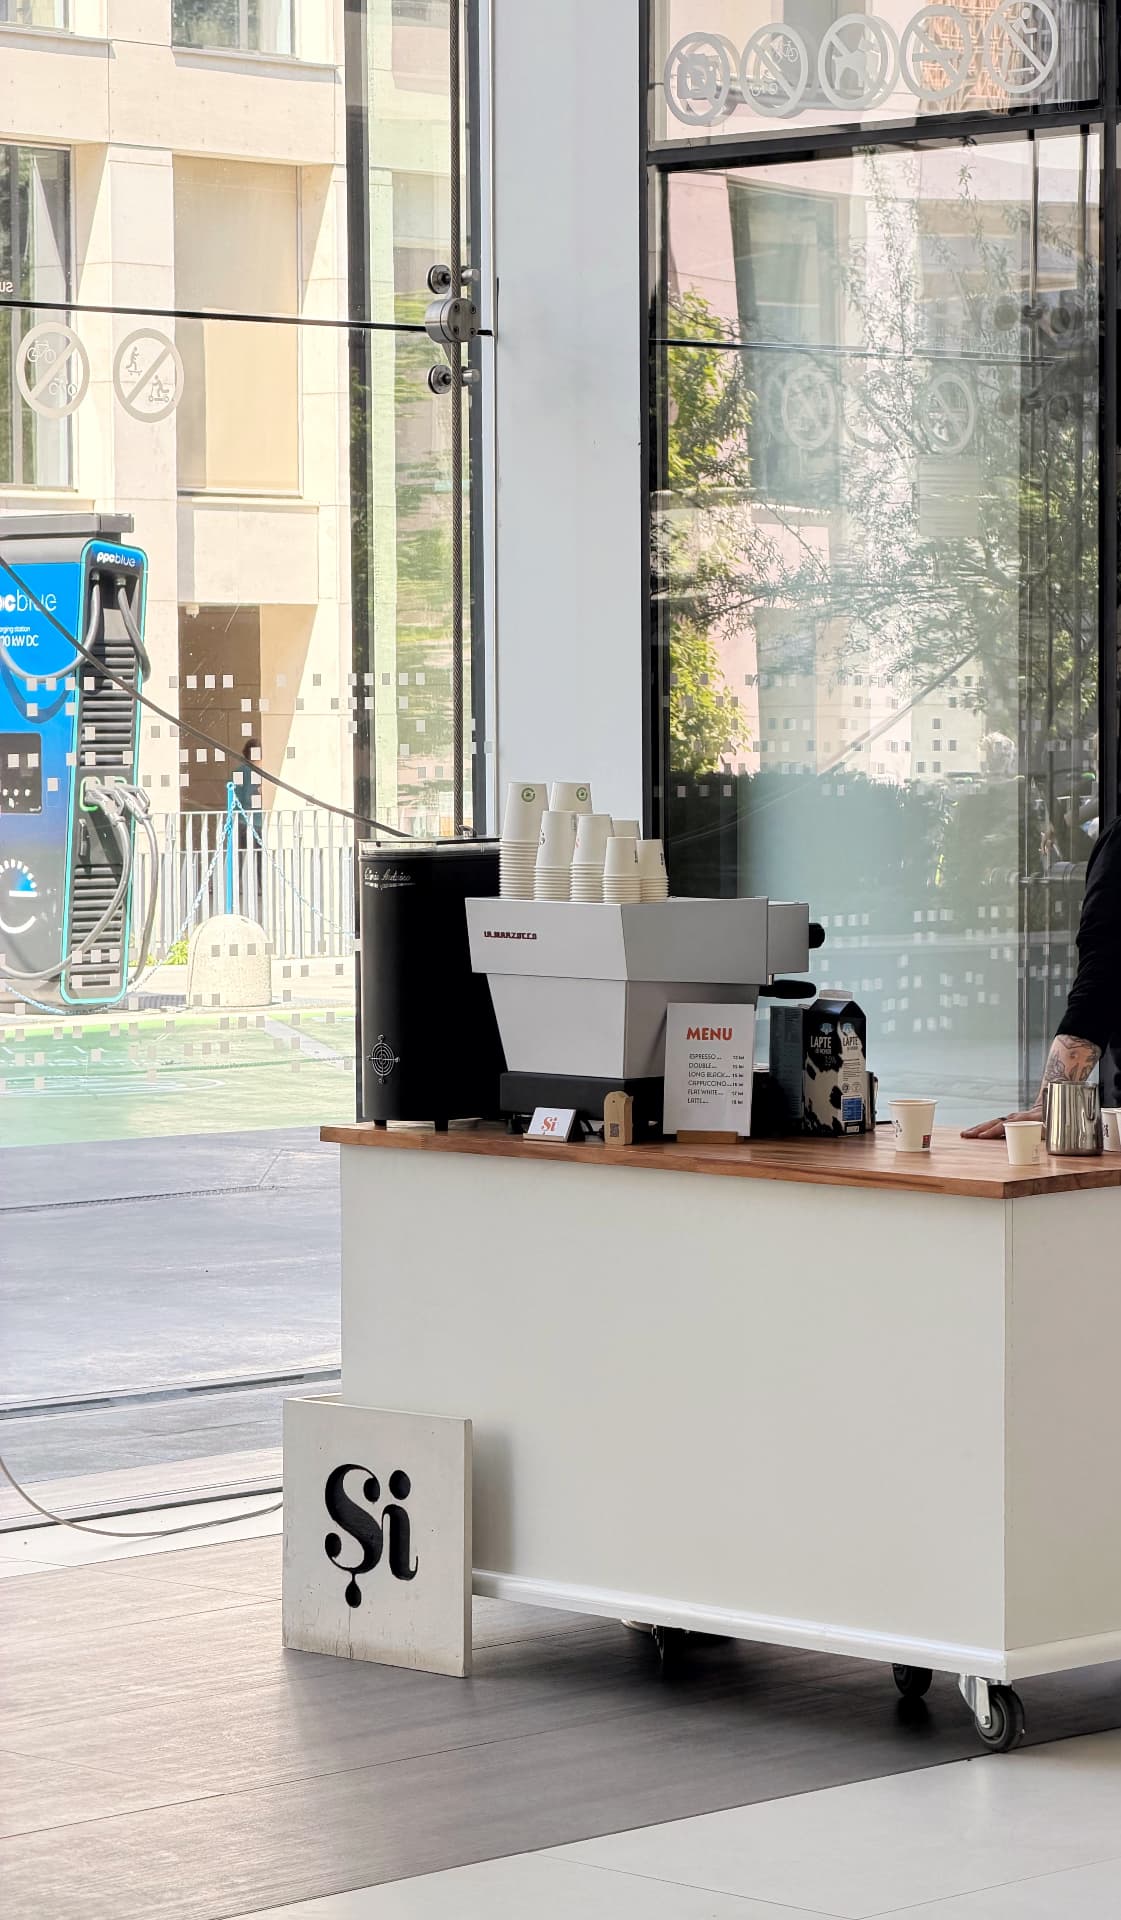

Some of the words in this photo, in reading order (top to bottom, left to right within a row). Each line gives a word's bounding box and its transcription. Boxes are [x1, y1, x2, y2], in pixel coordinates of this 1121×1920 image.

[96, 551, 136, 567] ppcblue
[11, 634, 25, 647] kW
[25, 634, 40, 647] DC
[686, 1026, 733, 1041] MENU
[810, 1035, 832, 1049] LAPTE
